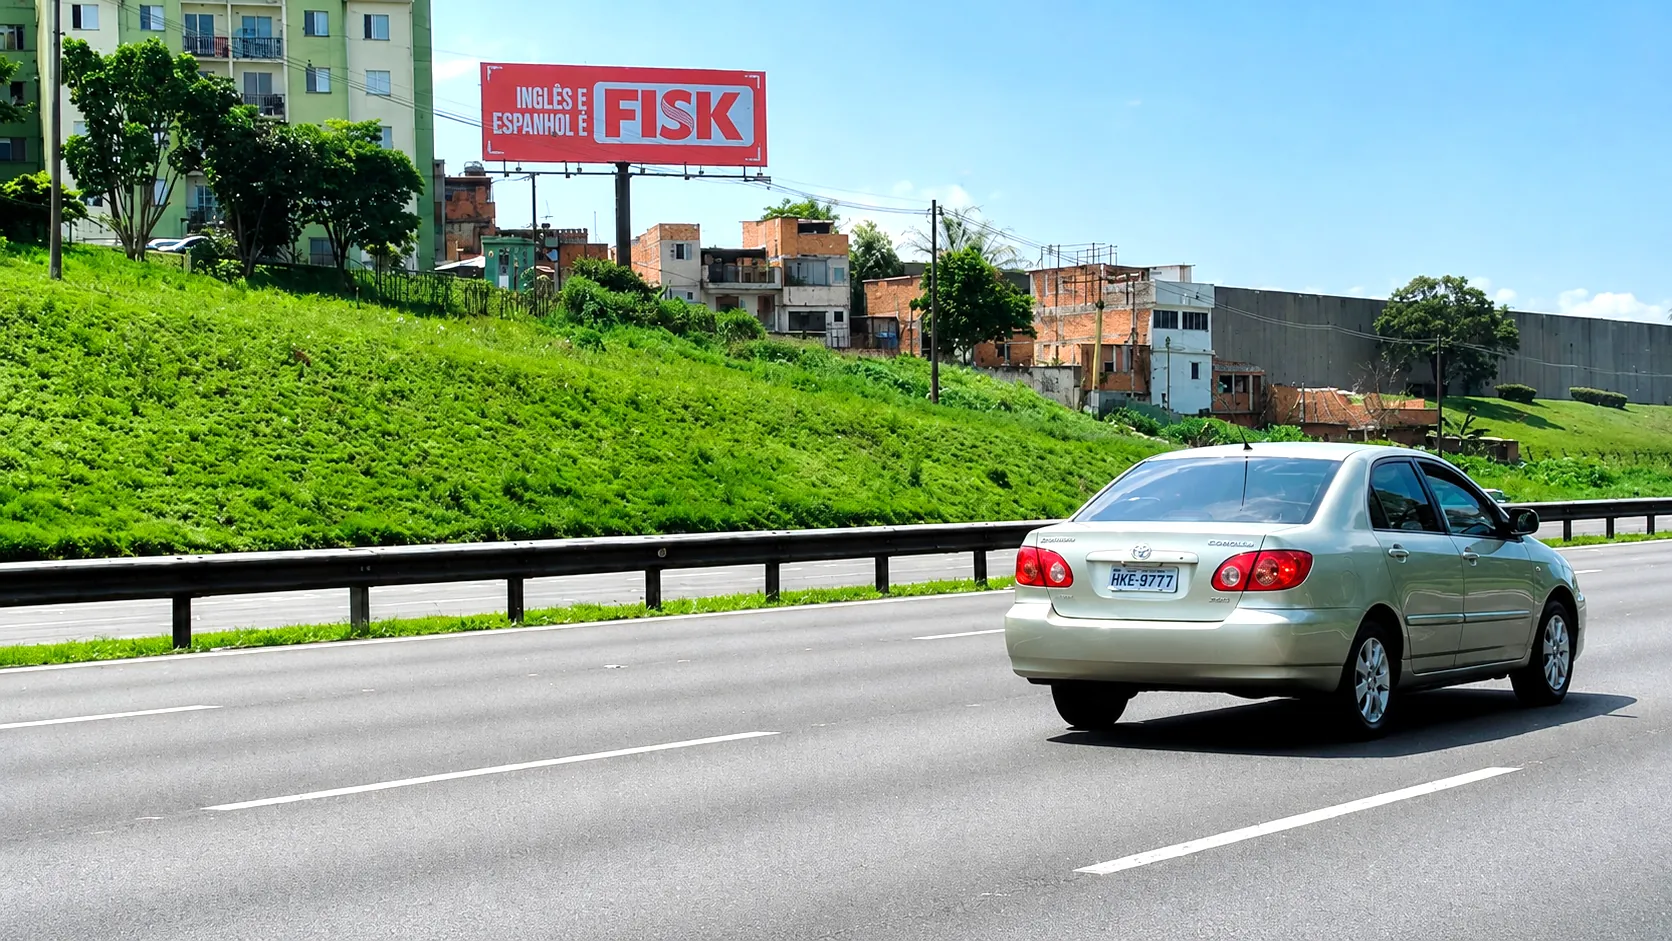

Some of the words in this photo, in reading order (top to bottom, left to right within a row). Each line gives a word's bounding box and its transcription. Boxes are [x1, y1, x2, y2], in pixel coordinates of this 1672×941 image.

[516, 83, 573, 110] INGLÊS
[577, 88, 587, 111] E
[493, 112, 574, 137] ESPANHOL
[578, 110, 588, 136] É
[604, 88, 744, 141] FISK
[1111, 573, 1174, 588] HKE-9777
